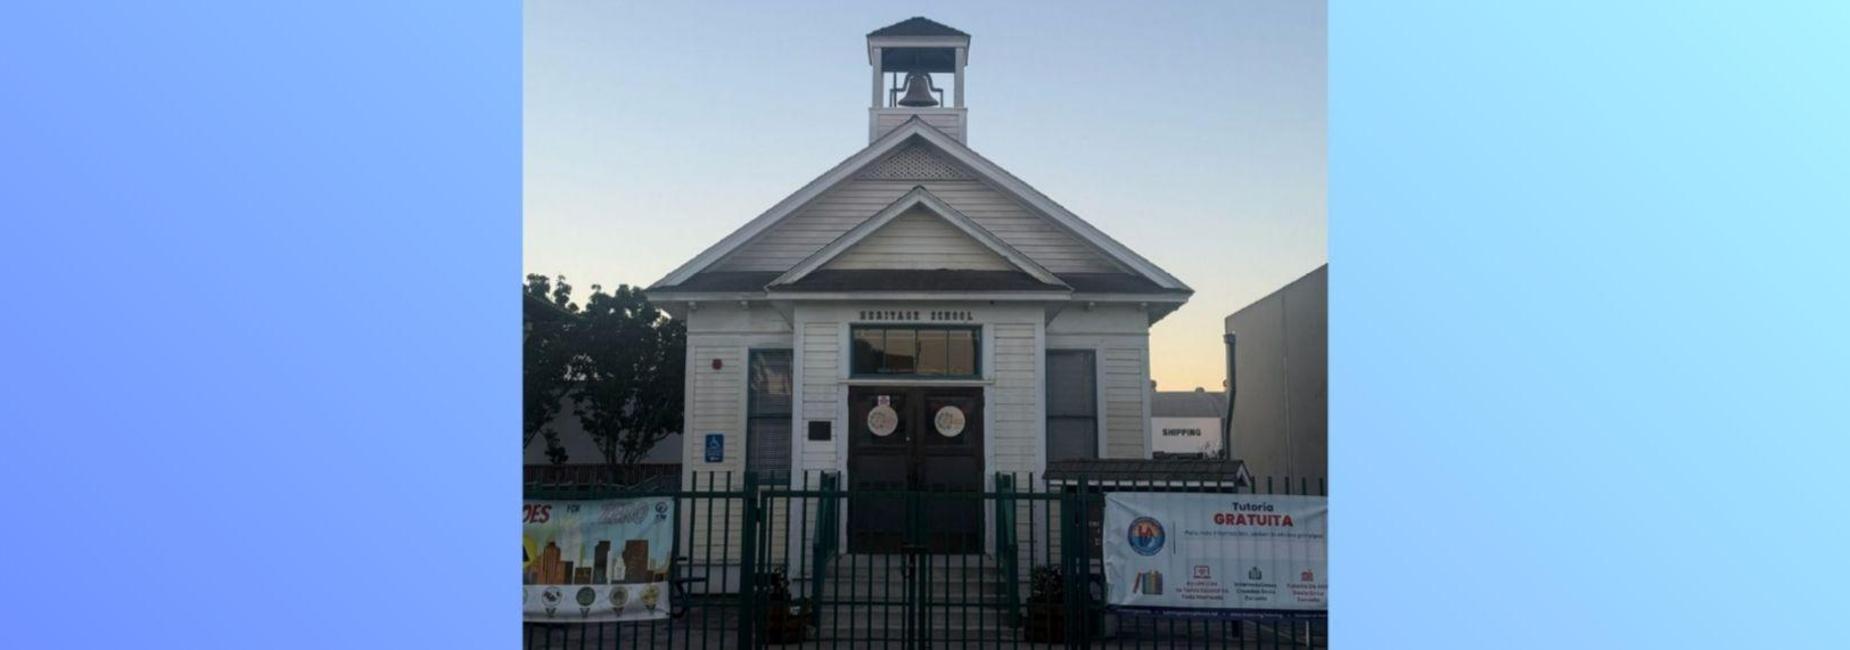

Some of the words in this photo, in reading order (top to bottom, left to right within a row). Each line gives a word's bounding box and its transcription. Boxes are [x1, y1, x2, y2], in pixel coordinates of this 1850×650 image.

[859, 311, 920, 321] HERITAGE
[930, 311, 973, 321] SCHOOL
[1162, 428, 1201, 436] SHIPPING
[1213, 513, 1294, 527] GRATUITA
